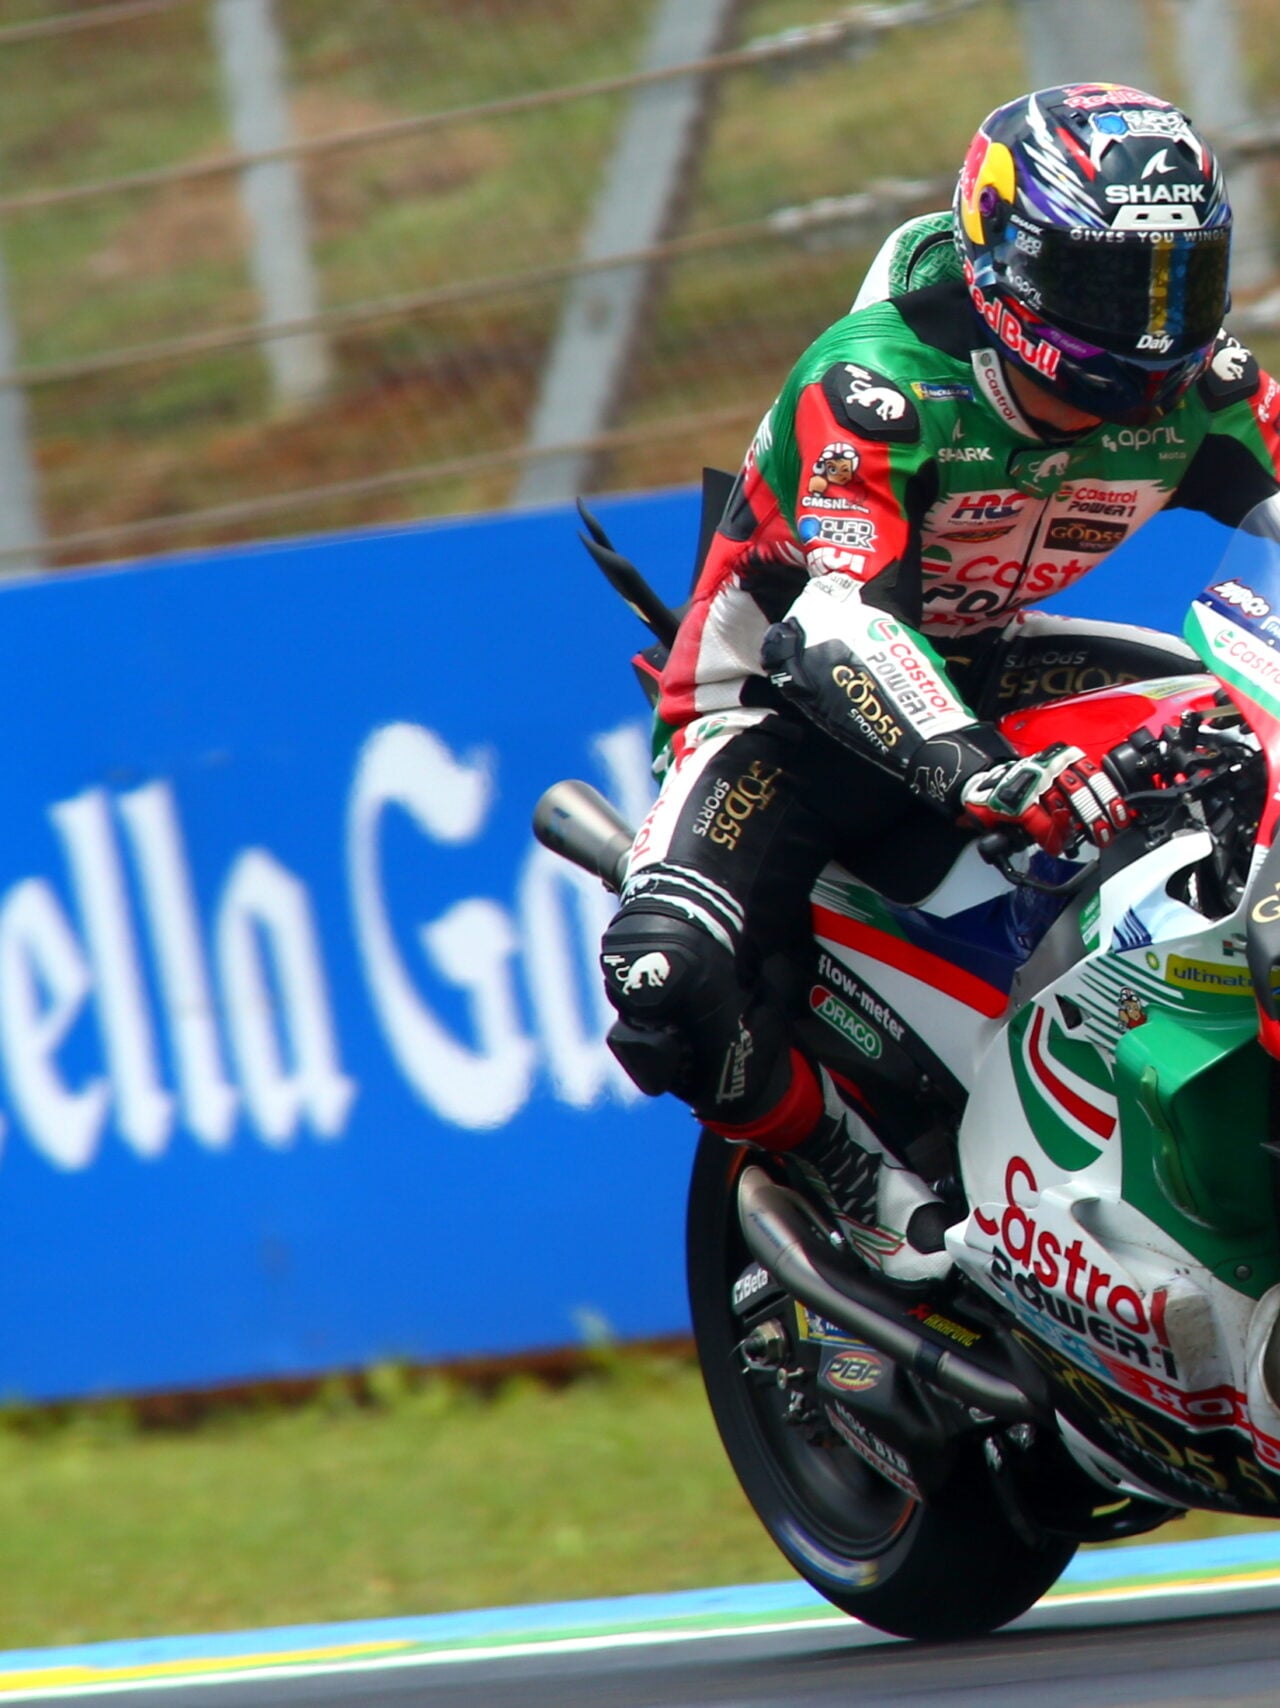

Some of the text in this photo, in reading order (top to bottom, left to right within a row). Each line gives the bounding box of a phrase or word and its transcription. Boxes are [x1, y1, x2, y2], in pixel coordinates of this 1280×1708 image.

[1105, 183, 1205, 204] SHARK
[1010, 214, 1043, 235] SHARK
[1069, 226, 1126, 243] GIVES
[1137, 230, 1175, 243] YOU
[963, 257, 1061, 381] Red Bull
[1136, 334, 1174, 352] Dafy
[984, 367, 1017, 421] Castrol
[938, 447, 994, 463] SHARK
[951, 493, 1029, 520] HRC
[1075, 487, 1138, 504] Castrol
[820, 531, 871, 549] LOCK
[821, 520, 872, 536] QUAD
[889, 642, 955, 714] Castrol
[849, 707, 891, 755] SPORTS
[692, 778, 731, 837] SPORTS
[0, 777, 354, 1173] ella
[1173, 966, 1252, 988] ultimat
[818, 953, 905, 1043] flow-meter
[823, 993, 877, 1054] DRACO
[974, 1155, 1173, 1349] Castrol
[743, 1267, 769, 1296] Beta
